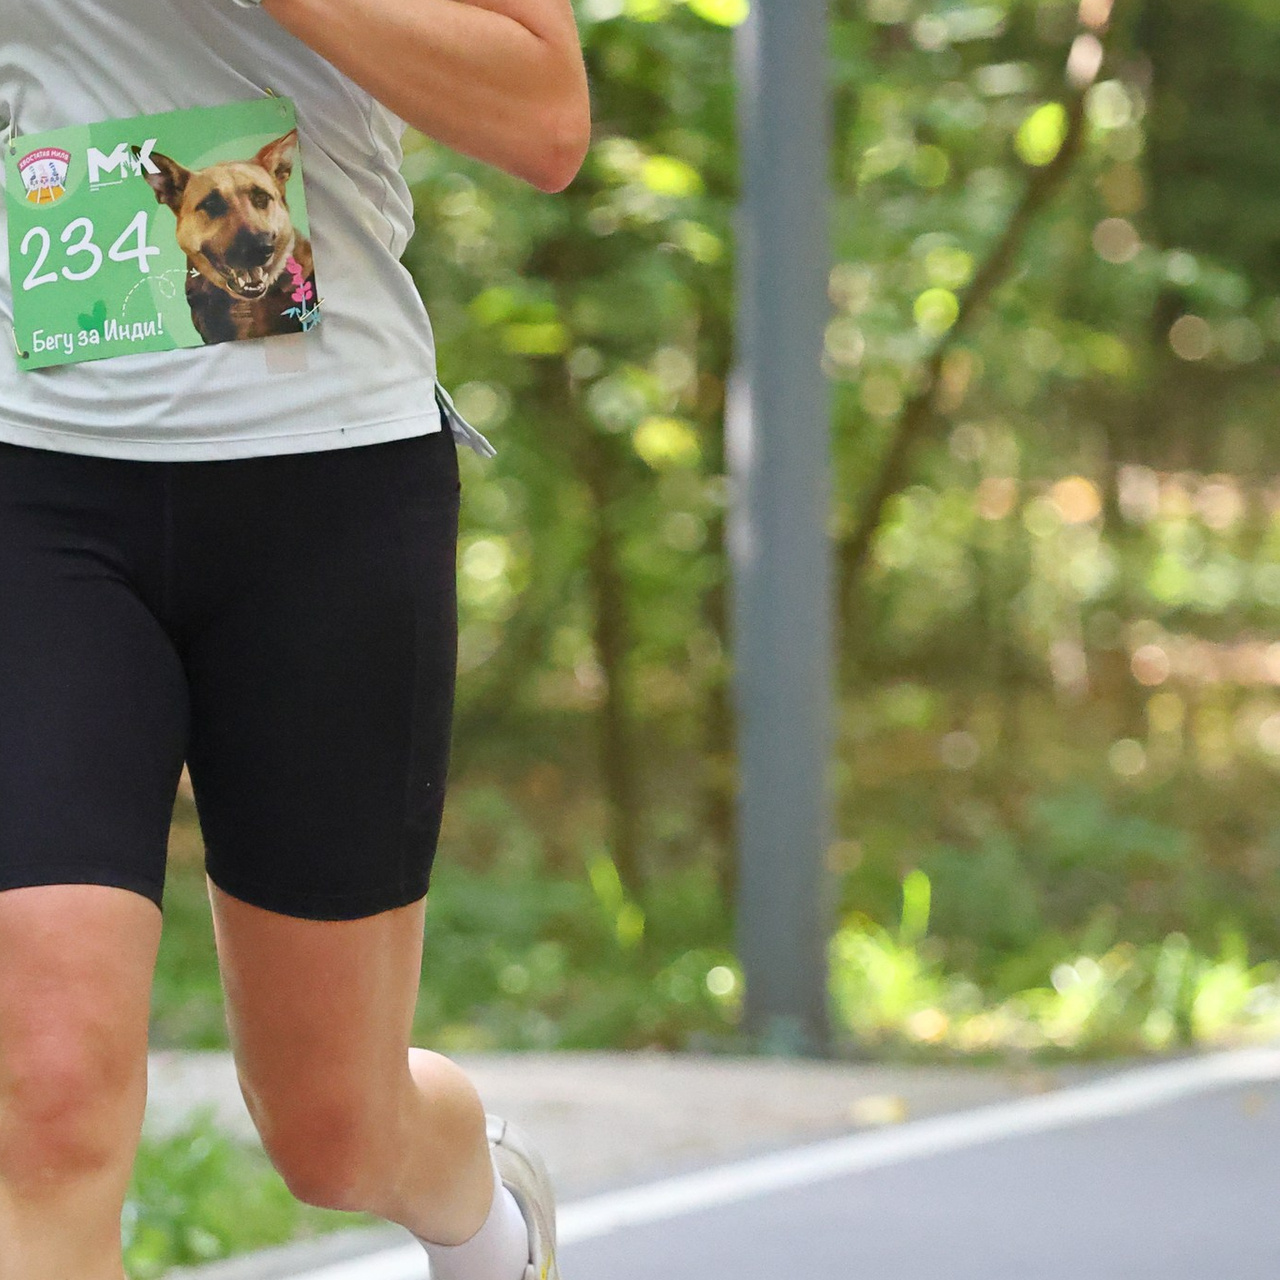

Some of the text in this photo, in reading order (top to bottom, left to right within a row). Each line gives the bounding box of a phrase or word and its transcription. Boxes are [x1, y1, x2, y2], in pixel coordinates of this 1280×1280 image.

[20, 210, 160, 291] 234
[32, 312, 164, 354] Бегу за Инди!
